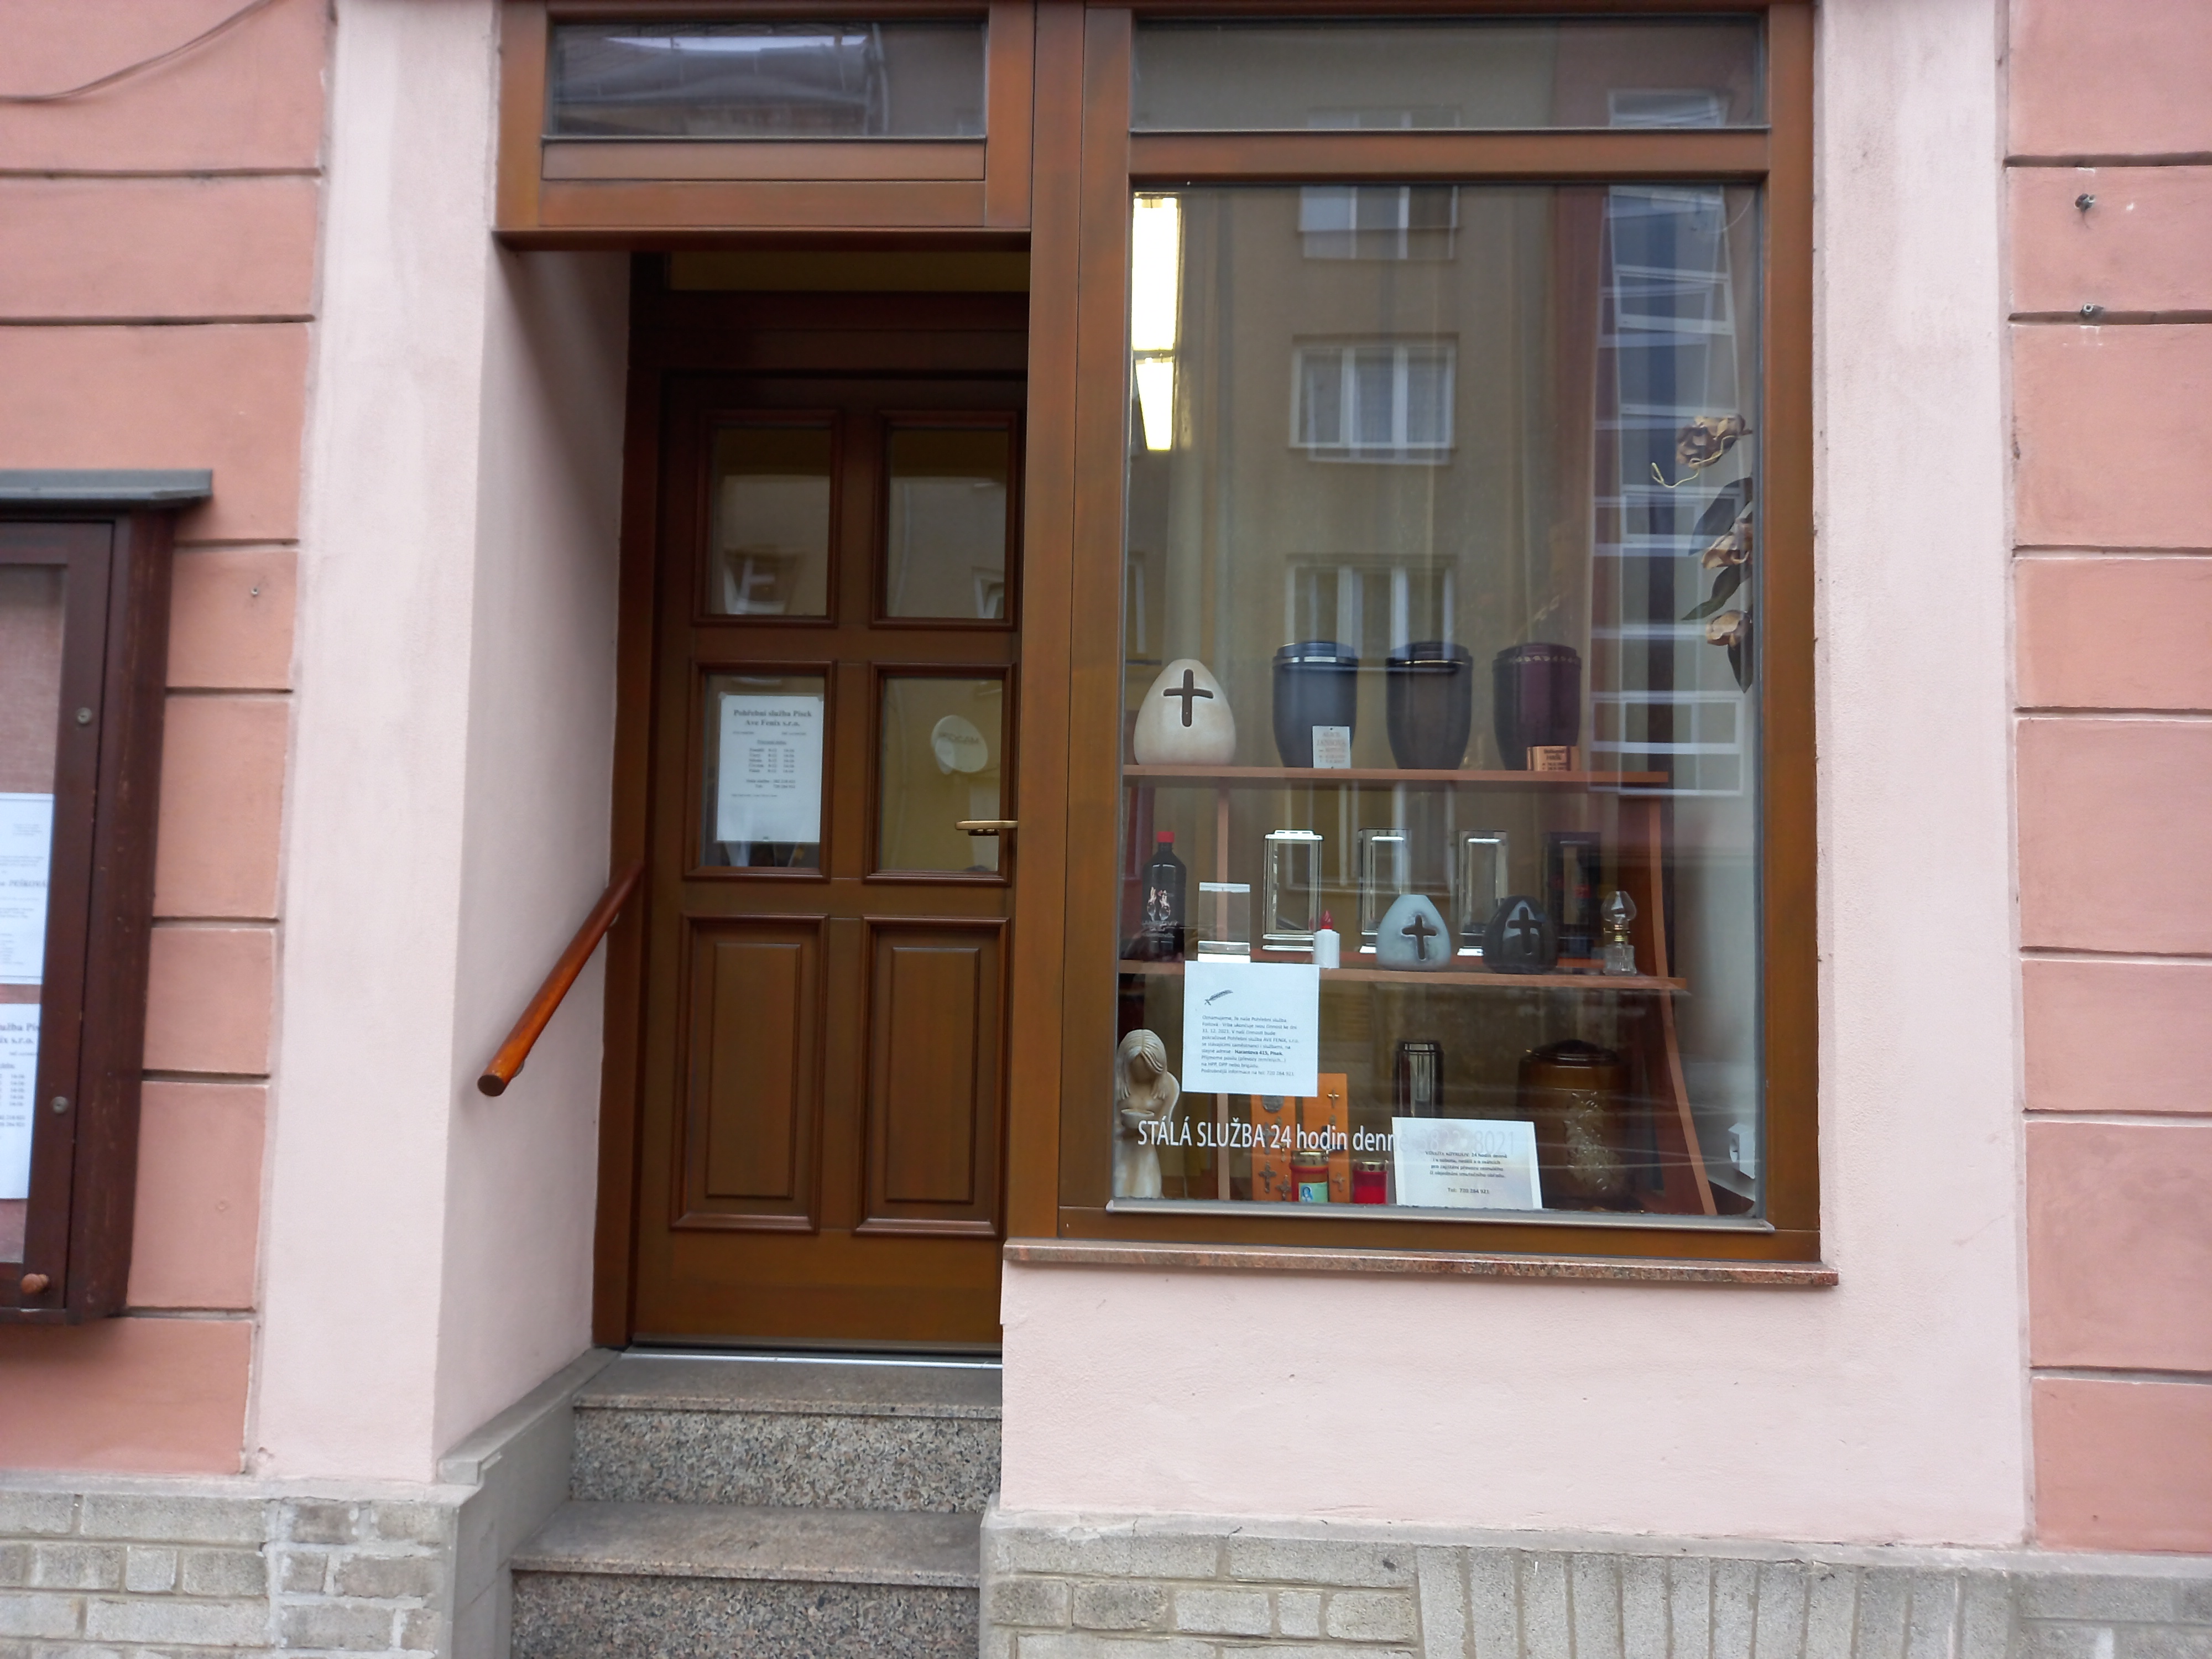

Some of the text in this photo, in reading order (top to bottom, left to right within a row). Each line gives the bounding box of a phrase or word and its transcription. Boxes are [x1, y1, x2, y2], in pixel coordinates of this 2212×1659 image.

[1138, 1116, 1192, 1146] STÁLÁ
[1196, 1117, 1266, 1148] SLUŽBA
[1271, 1124, 1292, 1149] 24
[1296, 1123, 1348, 1150] hodin
